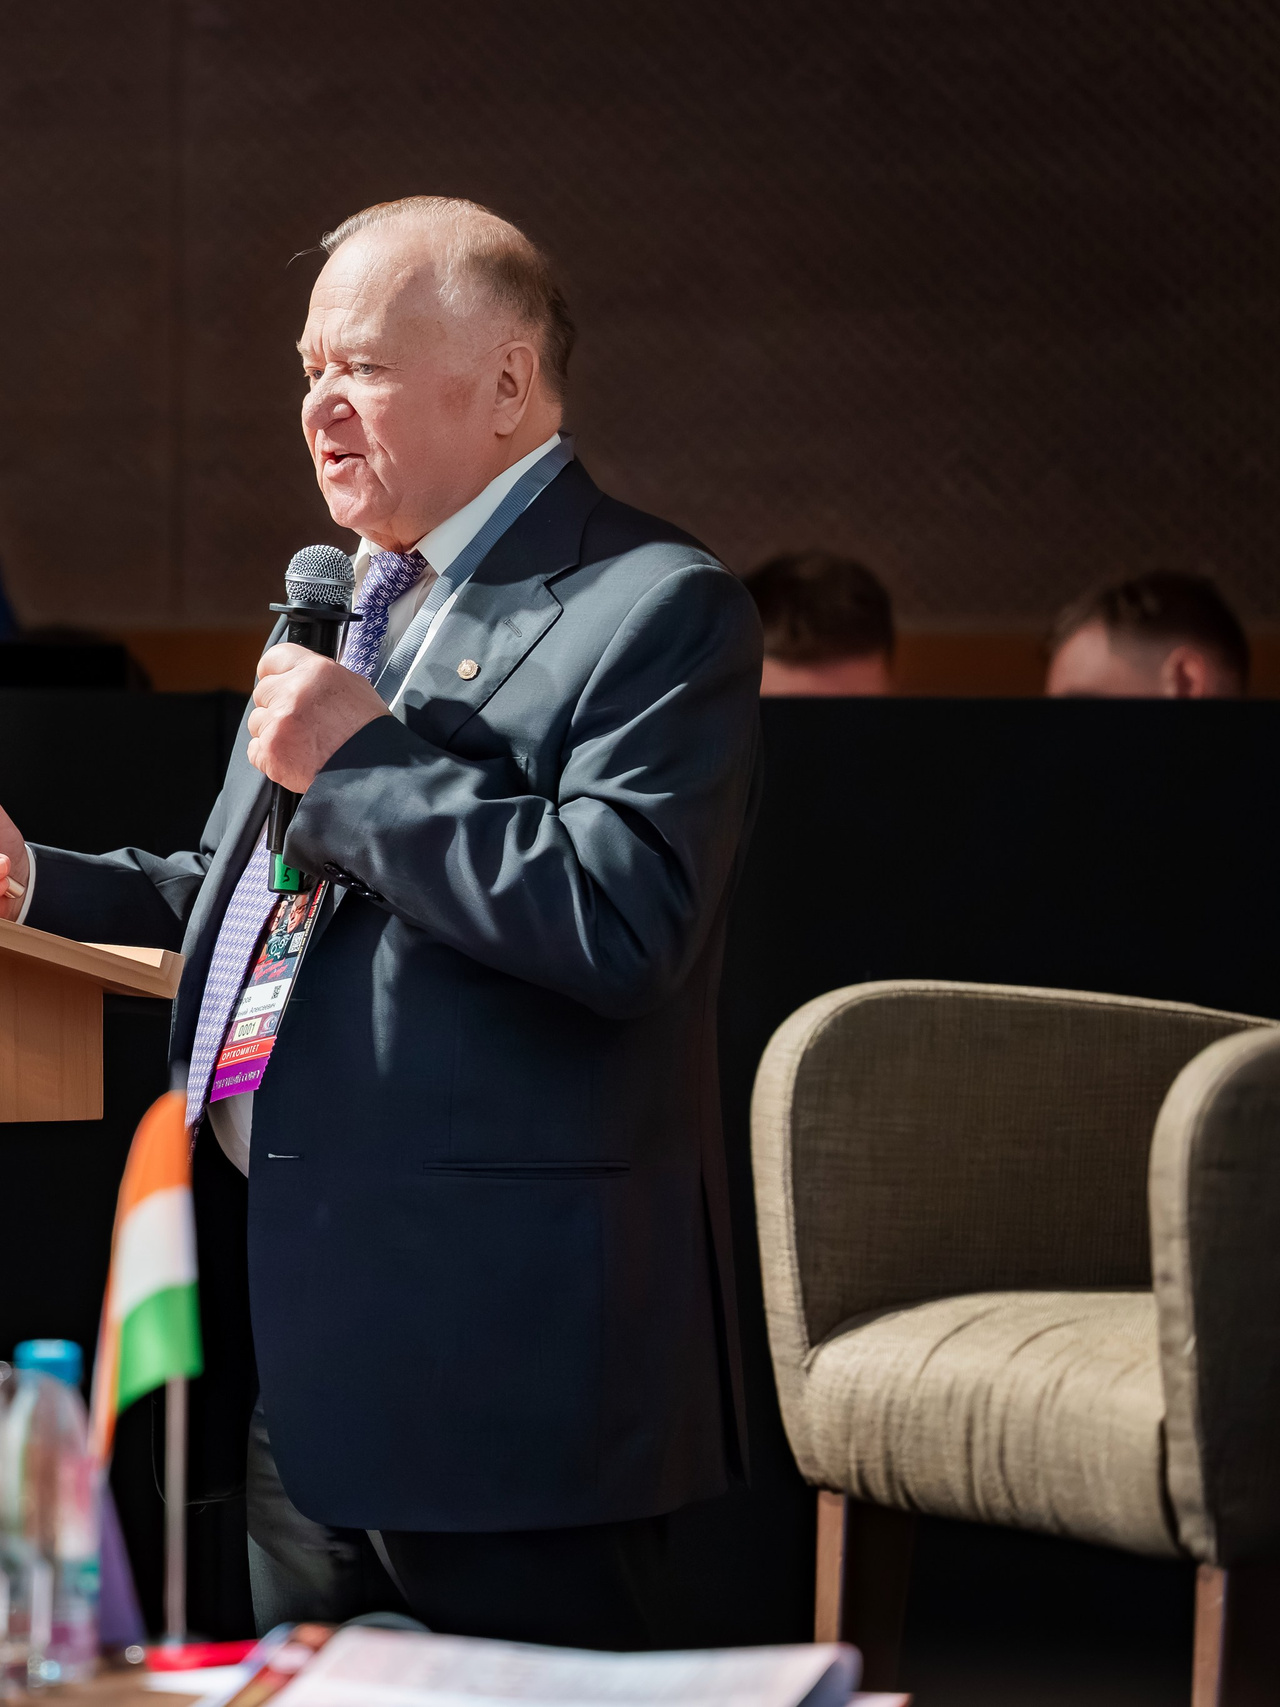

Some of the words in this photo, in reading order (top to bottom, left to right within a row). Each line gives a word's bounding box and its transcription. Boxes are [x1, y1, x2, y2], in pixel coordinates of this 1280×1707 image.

[282, 867, 292, 883] 5
[237, 1021, 257, 1038] 0001
[221, 1043, 260, 1061] ОРГКОМИТЕТ
